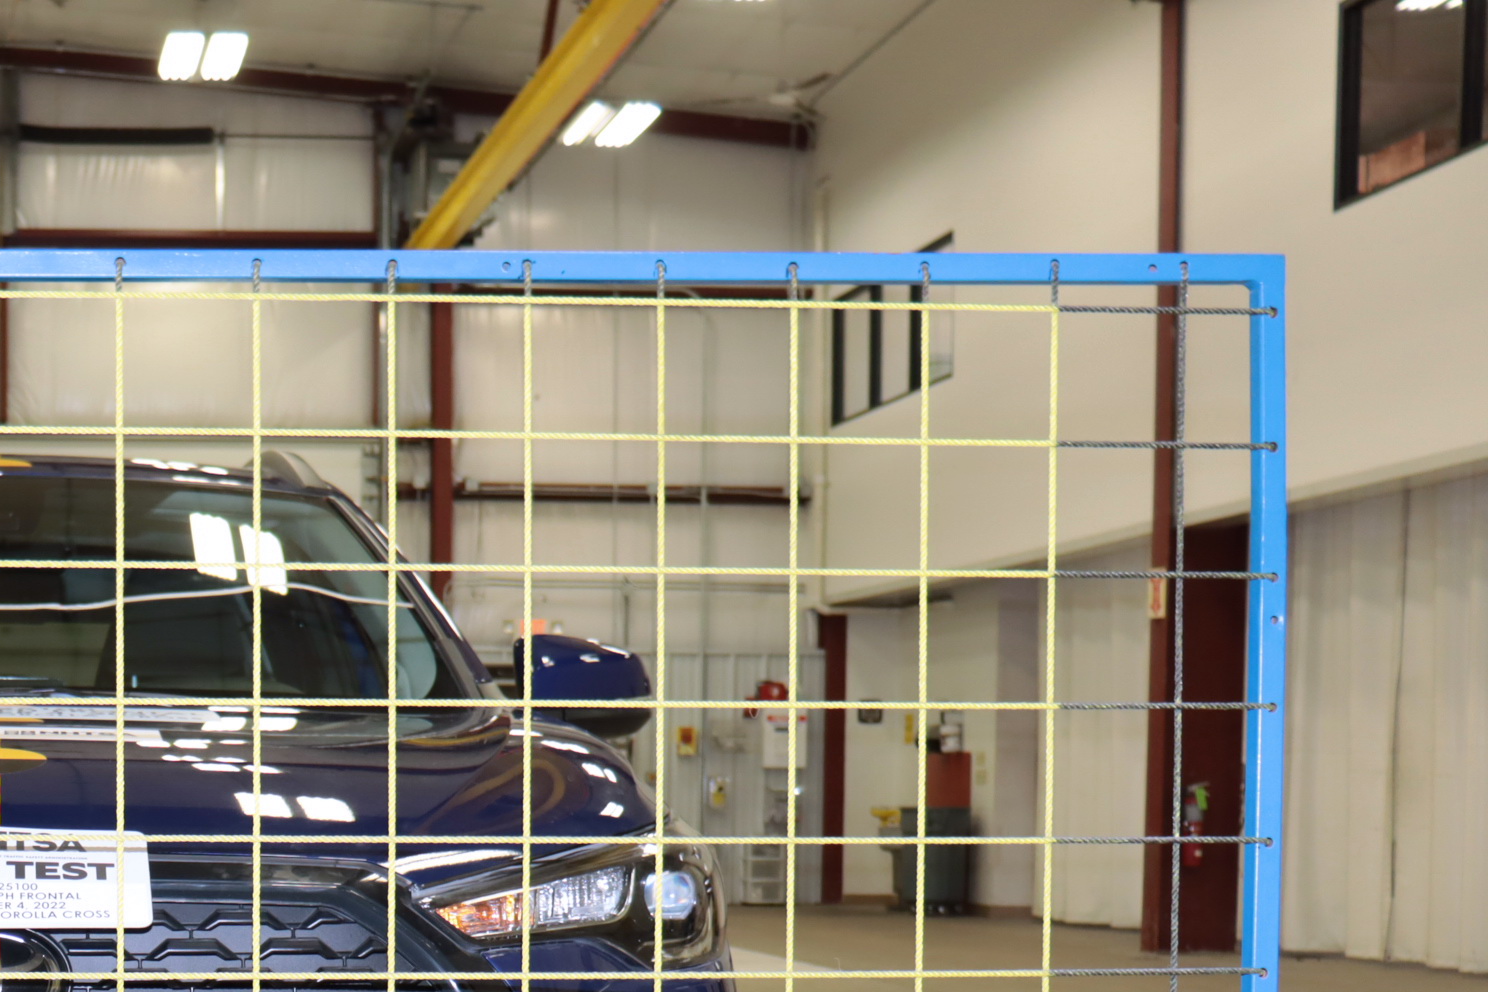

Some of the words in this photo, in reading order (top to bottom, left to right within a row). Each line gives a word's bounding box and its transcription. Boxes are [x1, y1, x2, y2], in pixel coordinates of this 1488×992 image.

[6, 861, 114, 880] TEST
[20, 892, 82, 900] FRONTAL
[34, 901, 66, 909] 2022
[63, 910, 111, 919] CROSS
